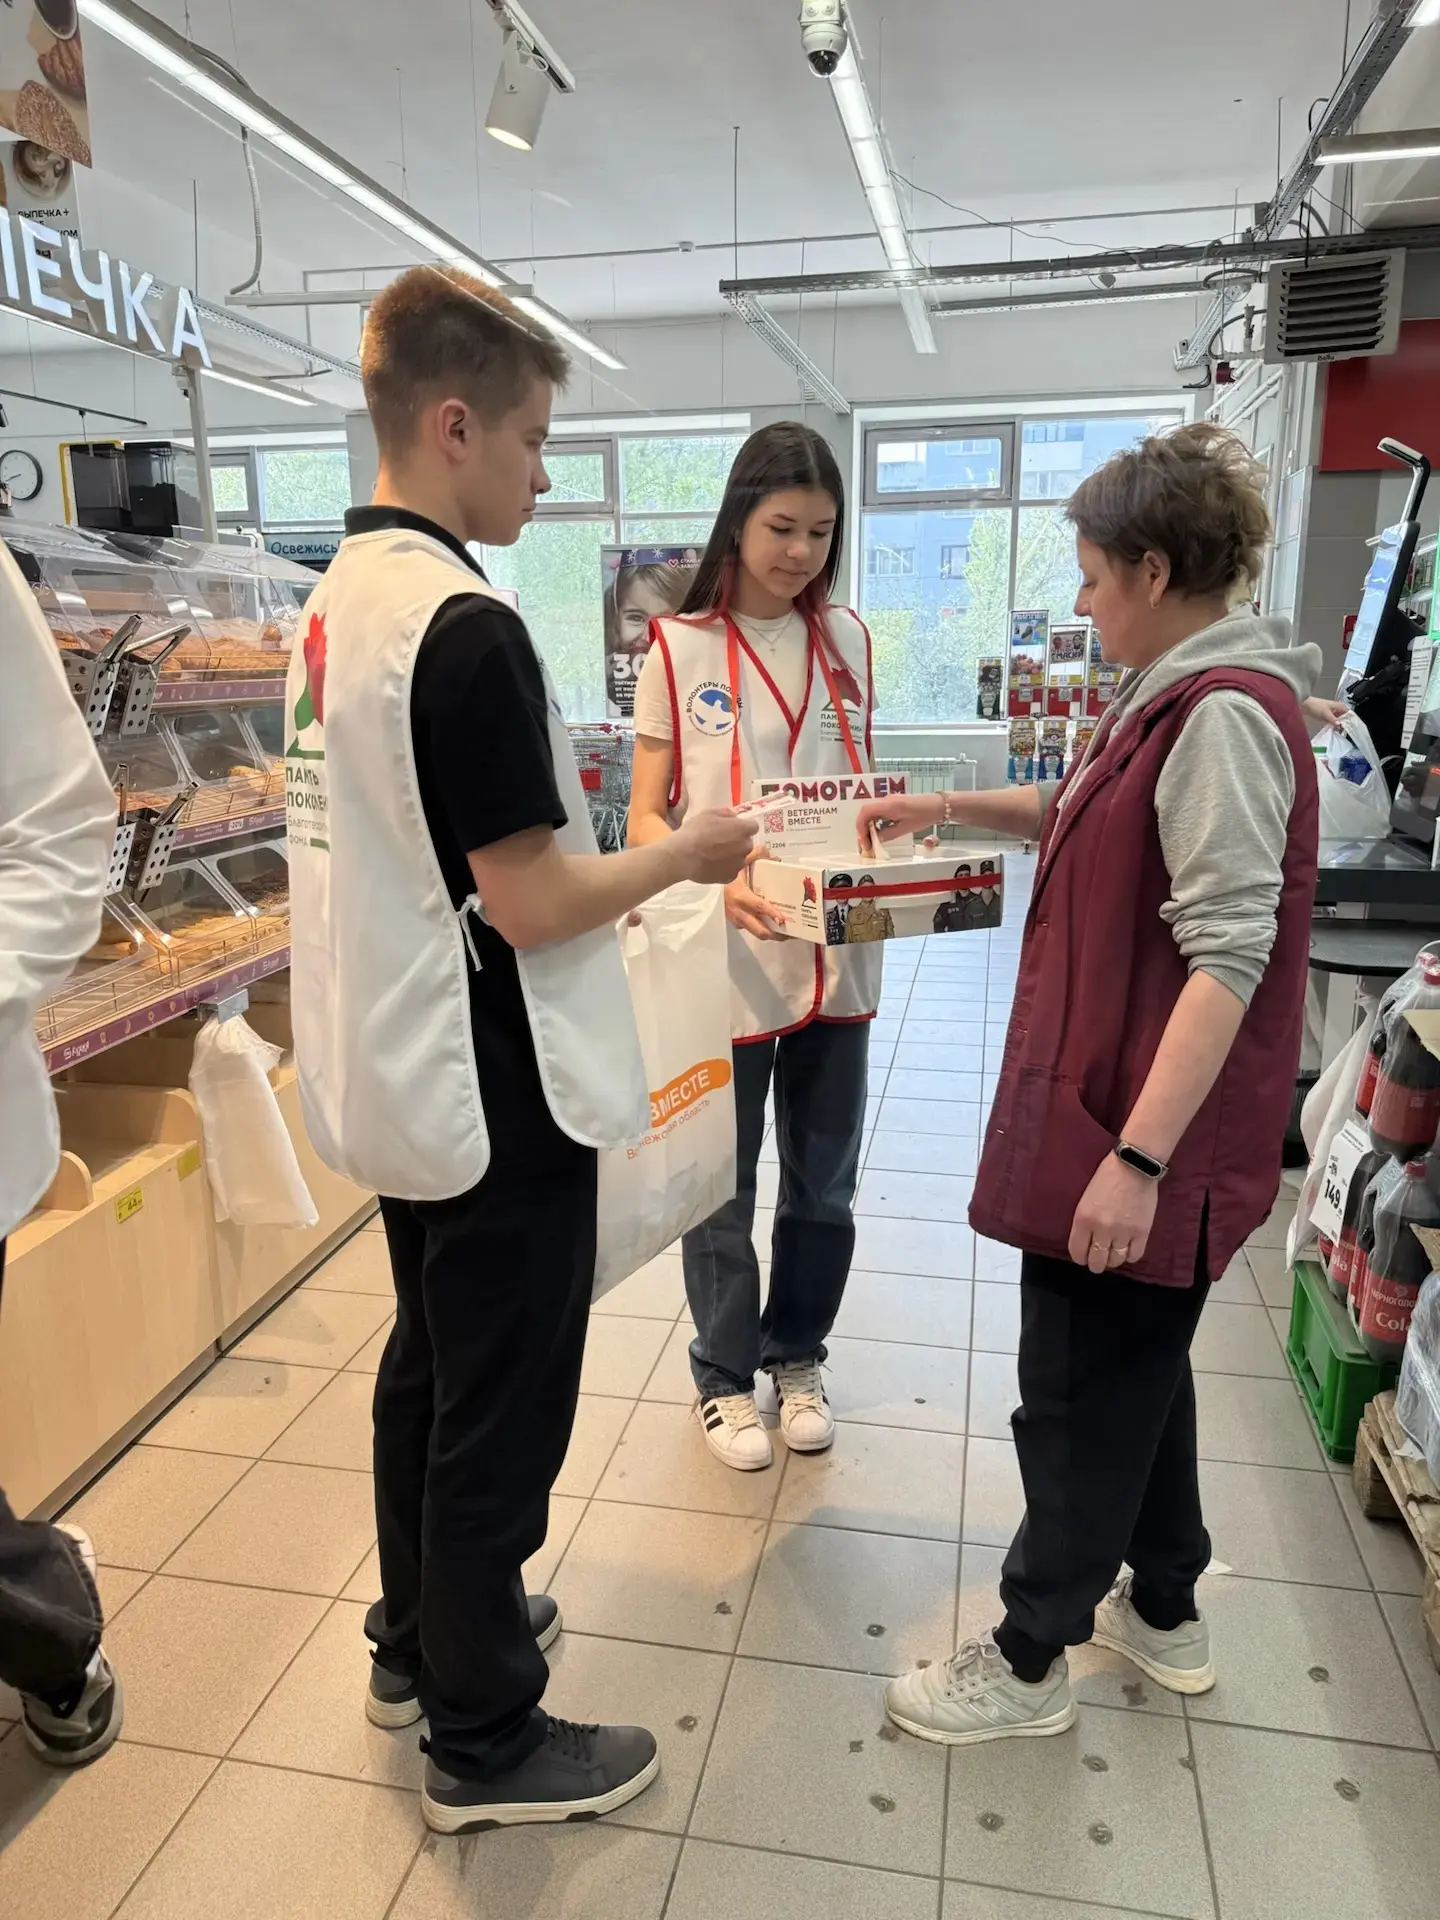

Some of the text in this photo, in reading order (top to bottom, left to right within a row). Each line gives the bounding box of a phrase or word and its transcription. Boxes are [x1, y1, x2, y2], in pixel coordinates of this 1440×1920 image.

[686, 681, 719, 713] ВОЛОНТЕРЫ
[787, 807, 838, 817] ВЕТЕРАНАМ
[788, 817, 822, 826] ВМЕСТЕ
[651, 1068, 710, 1121] ВМЕСТЕ
[1324, 1179, 1341, 1209] 149
[1375, 1312, 1408, 1332] Col
